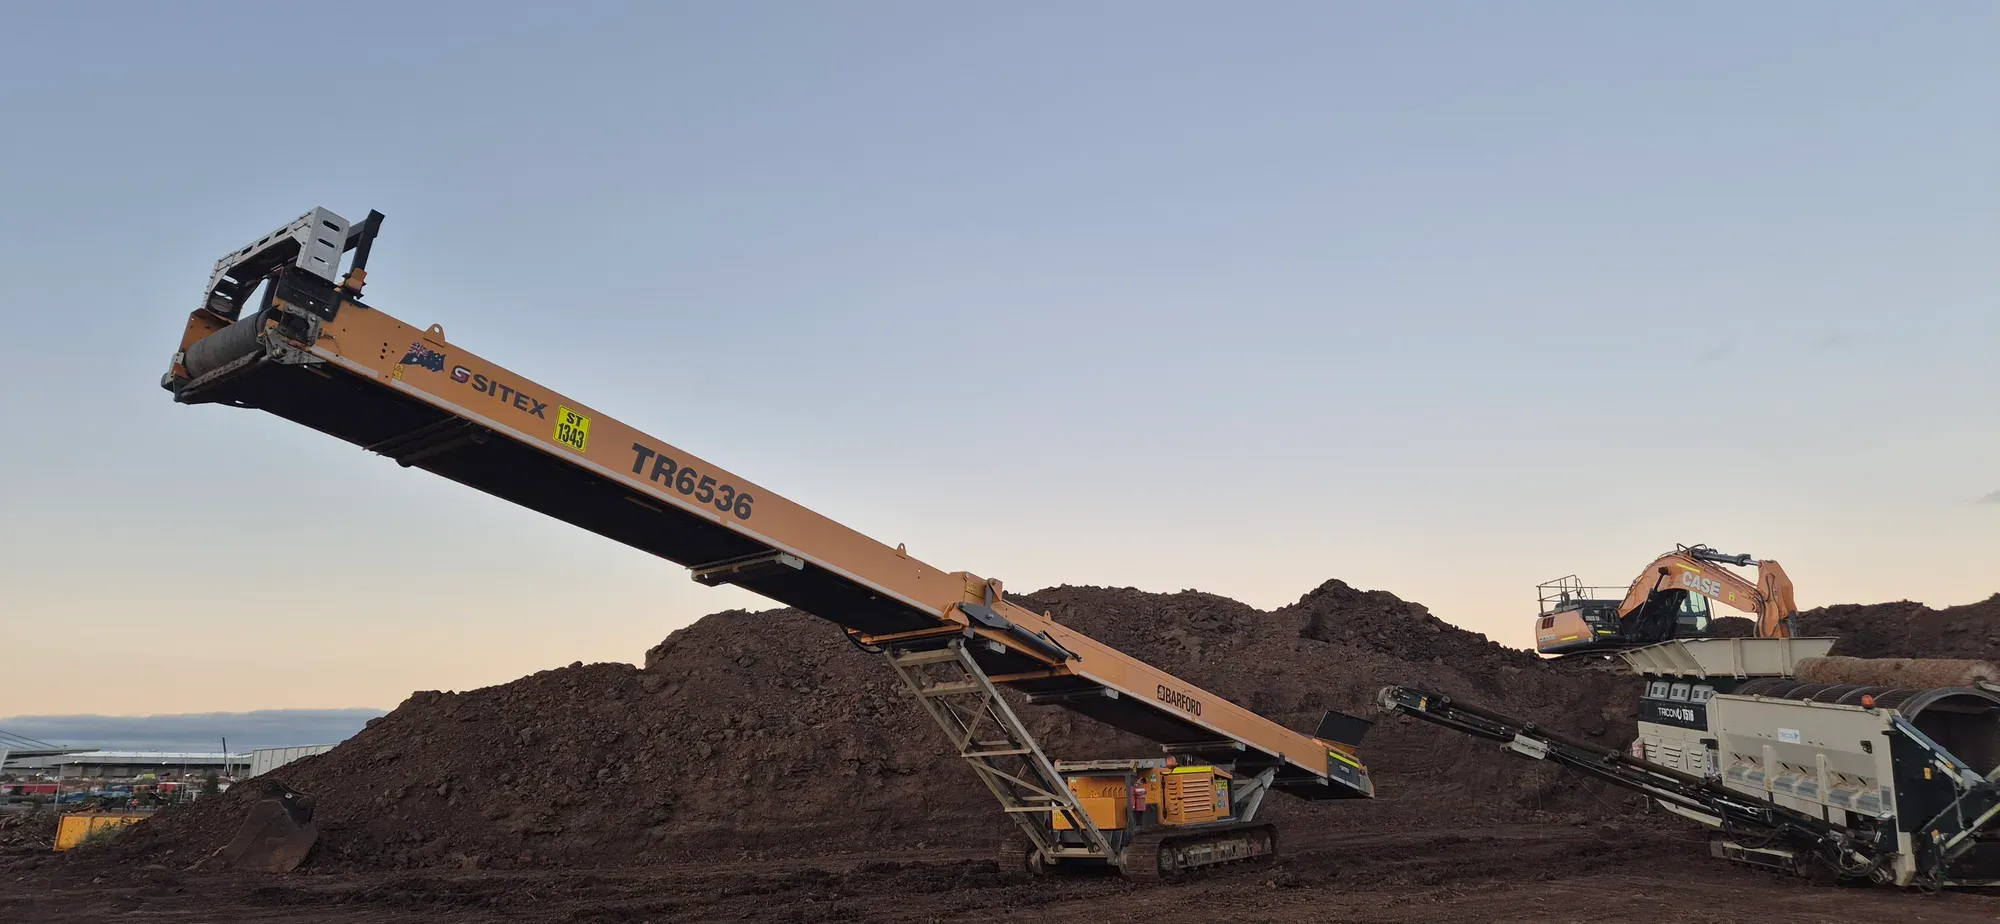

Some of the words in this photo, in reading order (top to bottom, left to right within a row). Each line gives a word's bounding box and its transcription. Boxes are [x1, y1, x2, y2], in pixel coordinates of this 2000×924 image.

[471, 373, 548, 420] SITEX
[566, 412, 583, 427] ST
[558, 422, 585, 449] 1343
[631, 442, 754, 520] TR6536
[1682, 571, 1721, 598] CASE
[1165, 687, 1202, 717] BARFORD
